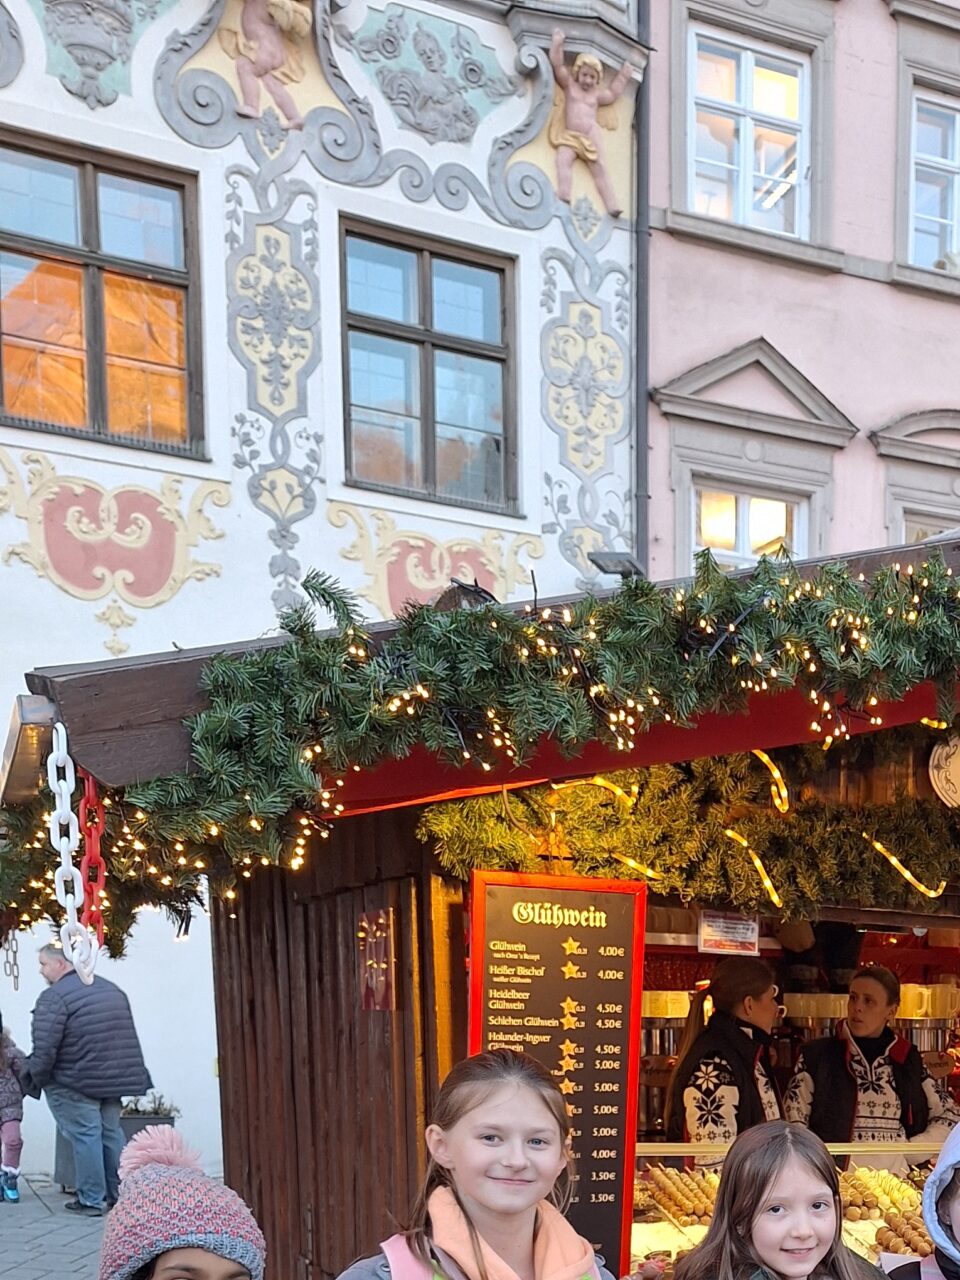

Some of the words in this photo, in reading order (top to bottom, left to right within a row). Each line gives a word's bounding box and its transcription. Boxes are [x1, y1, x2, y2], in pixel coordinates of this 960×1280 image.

[511, 901, 608, 928] Glühwein
[489, 941, 527, 951] Glühwein
[489, 965, 515, 975] Heißer
[516, 966, 546, 976] Bischof
[488, 989, 530, 999] Heidelbeer
[488, 1001, 525, 1010] Glühwein
[488, 1016, 522, 1026] Schlehen
[524, 1017, 559, 1027] Glühwein
[487, 1032, 551, 1044] Holunder-Ingwer
